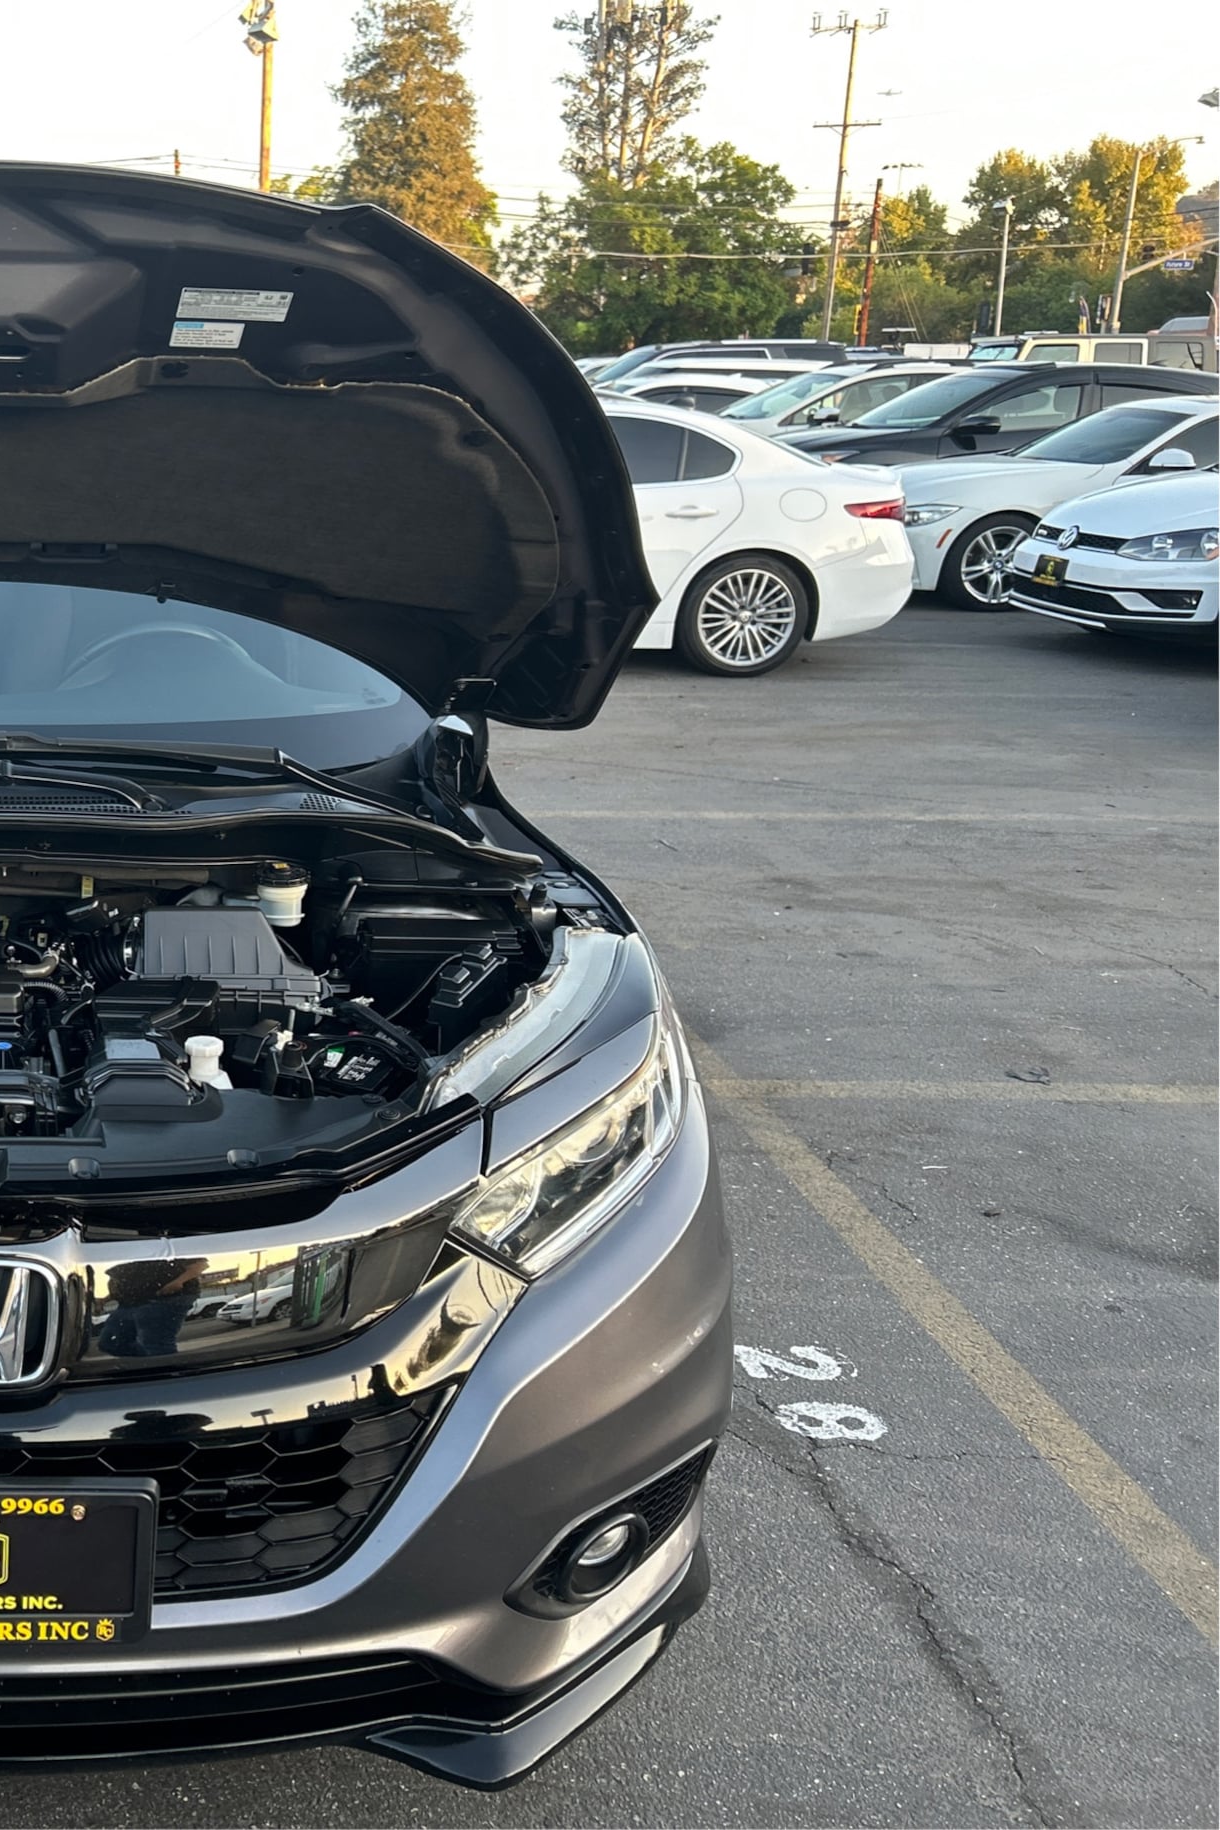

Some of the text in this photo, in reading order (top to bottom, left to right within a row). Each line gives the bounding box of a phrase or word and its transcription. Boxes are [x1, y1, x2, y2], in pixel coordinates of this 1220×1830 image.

[0, 1498, 66, 1514] 9966
[22, 1596, 64, 1610] INC.
[37, 1621, 89, 1641] INC
